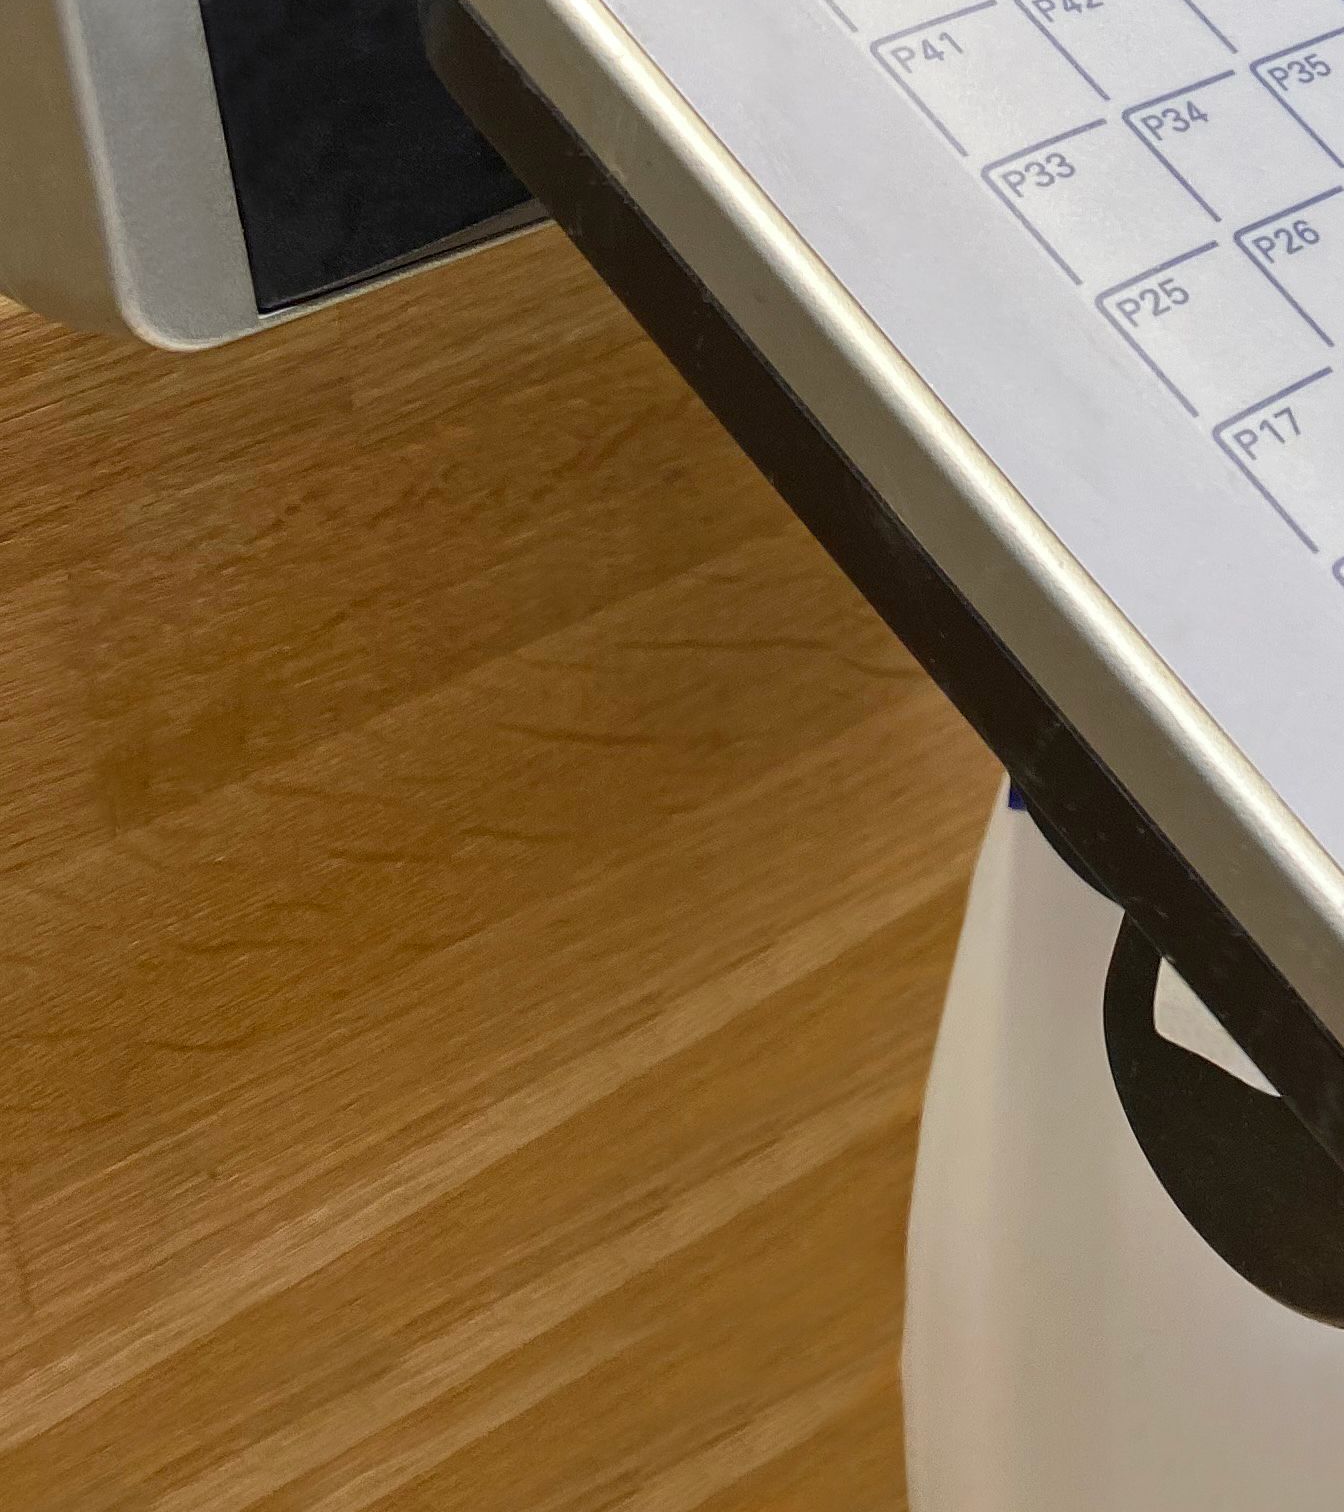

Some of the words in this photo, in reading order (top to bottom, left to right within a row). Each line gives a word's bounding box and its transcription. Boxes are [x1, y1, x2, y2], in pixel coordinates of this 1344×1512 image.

[890, 32, 964, 73] P41
[1001, 153, 1076, 197] P33
[1140, 101, 1208, 140] P34
[1266, 54, 1331, 90] P35
[1116, 278, 1189, 326] P25
[1252, 220, 1320, 263] P26
[1233, 407, 1302, 460] P17
